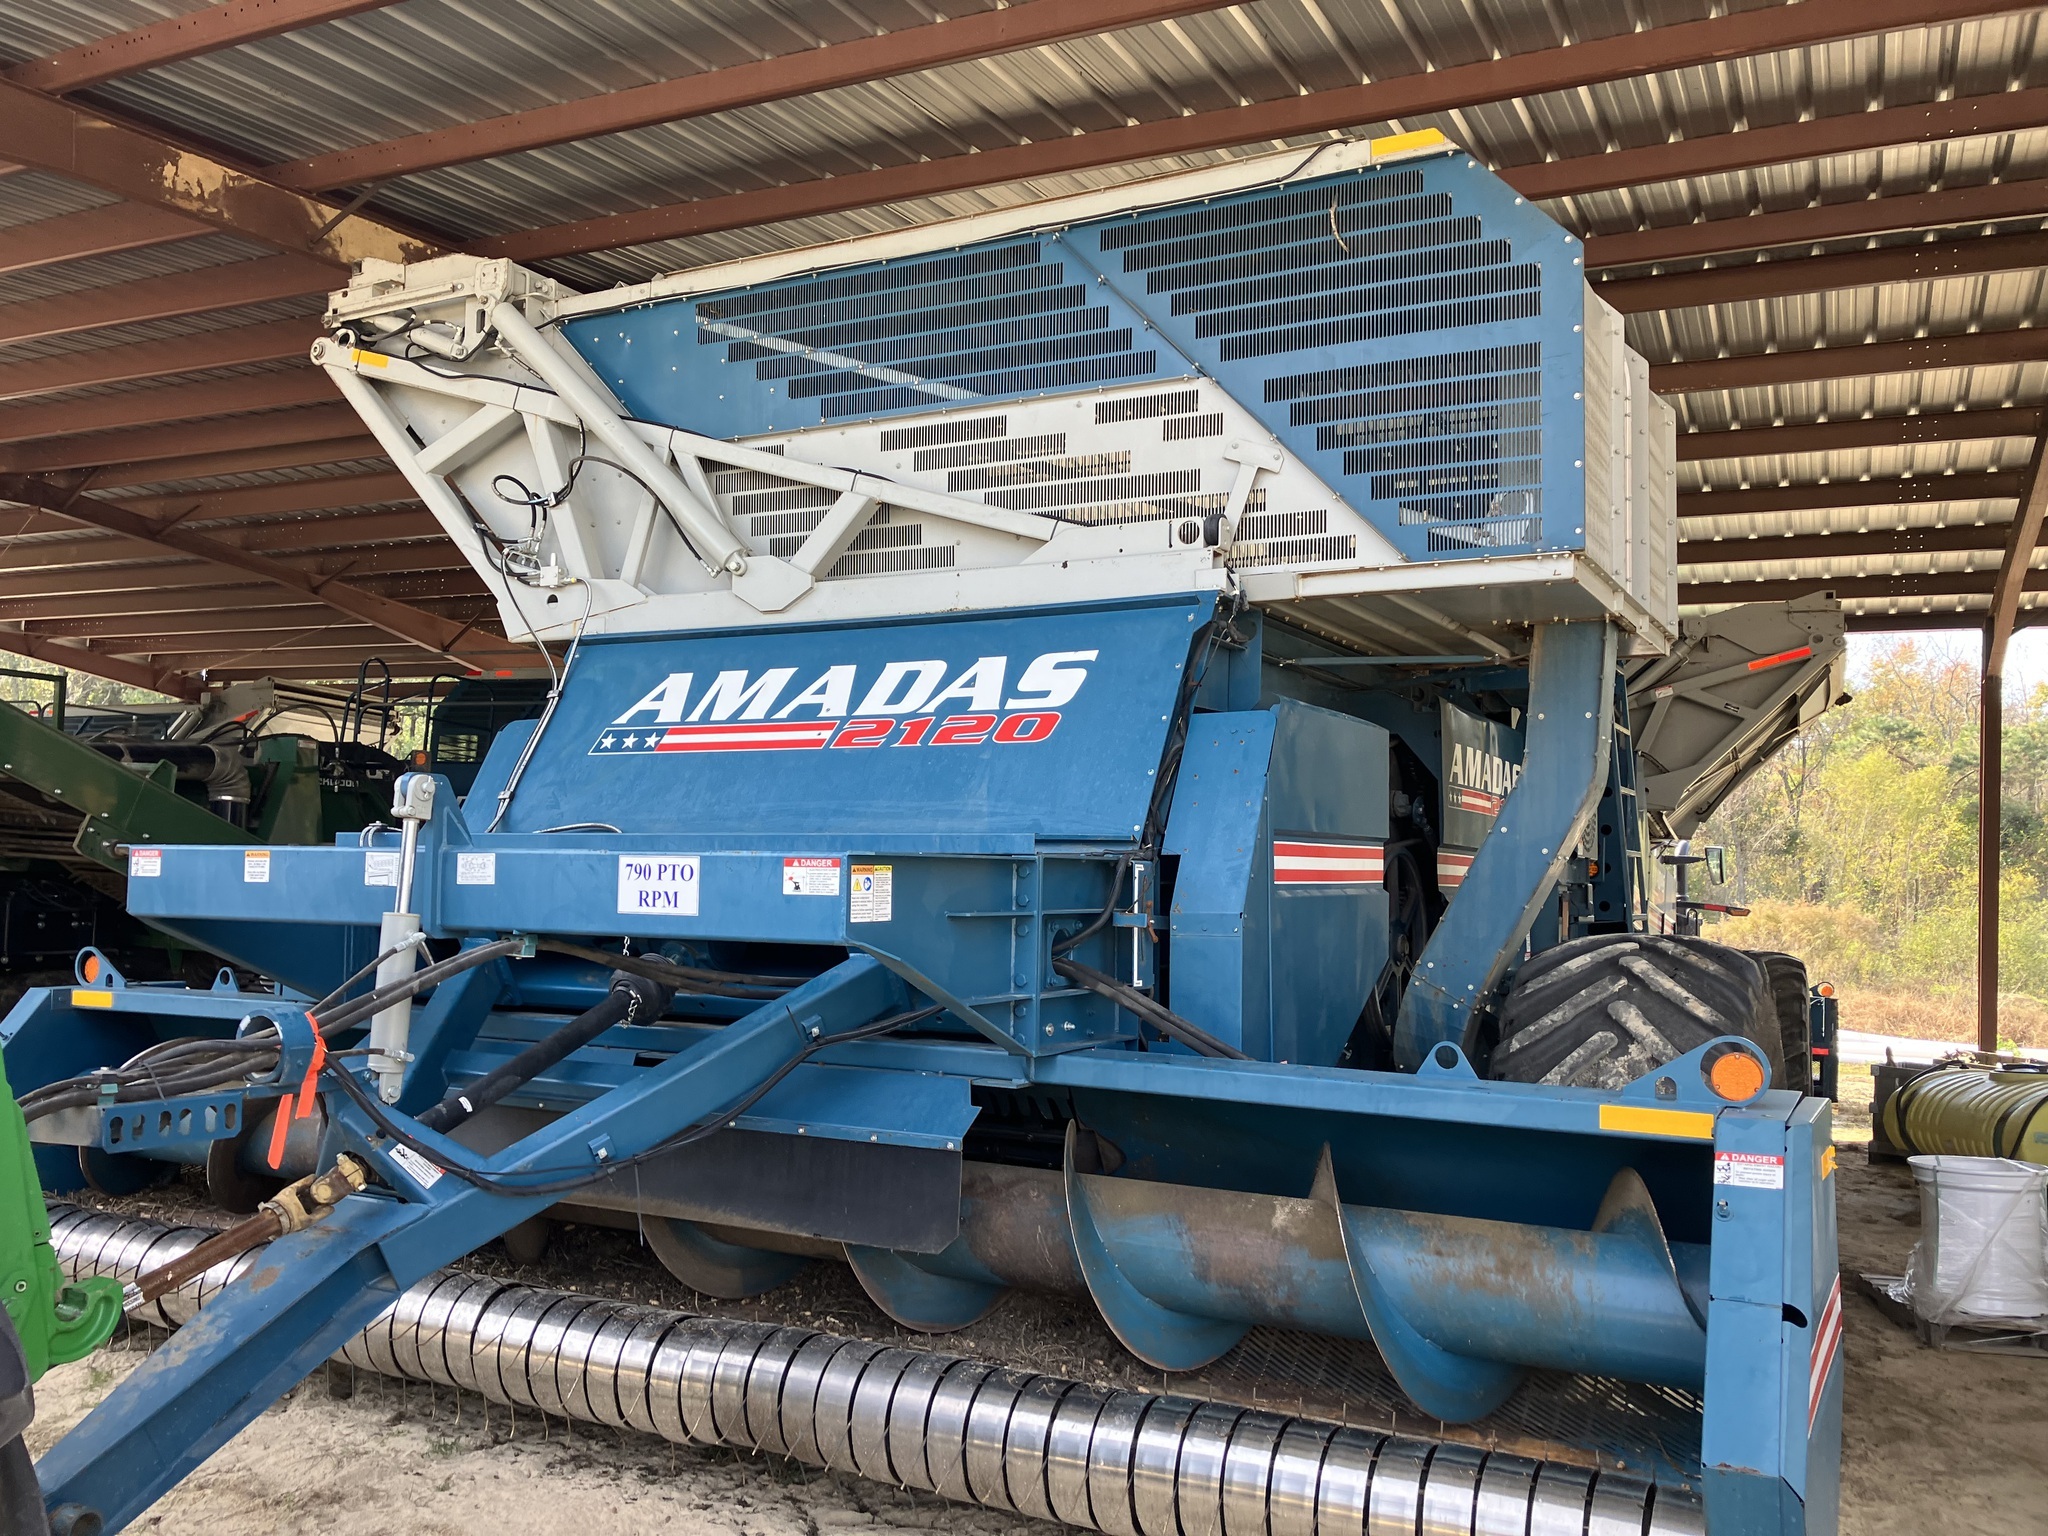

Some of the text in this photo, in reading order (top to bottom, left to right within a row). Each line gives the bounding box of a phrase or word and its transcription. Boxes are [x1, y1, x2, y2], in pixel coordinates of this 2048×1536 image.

[611, 649, 1099, 724] AMADAS
[829, 701, 1061, 749] 2120
[801, 859, 832, 867] DANGER
[625, 863, 694, 882] 790 PTO
[638, 890, 679, 908] RPM
[1731, 1153, 1777, 1164] DANGER
